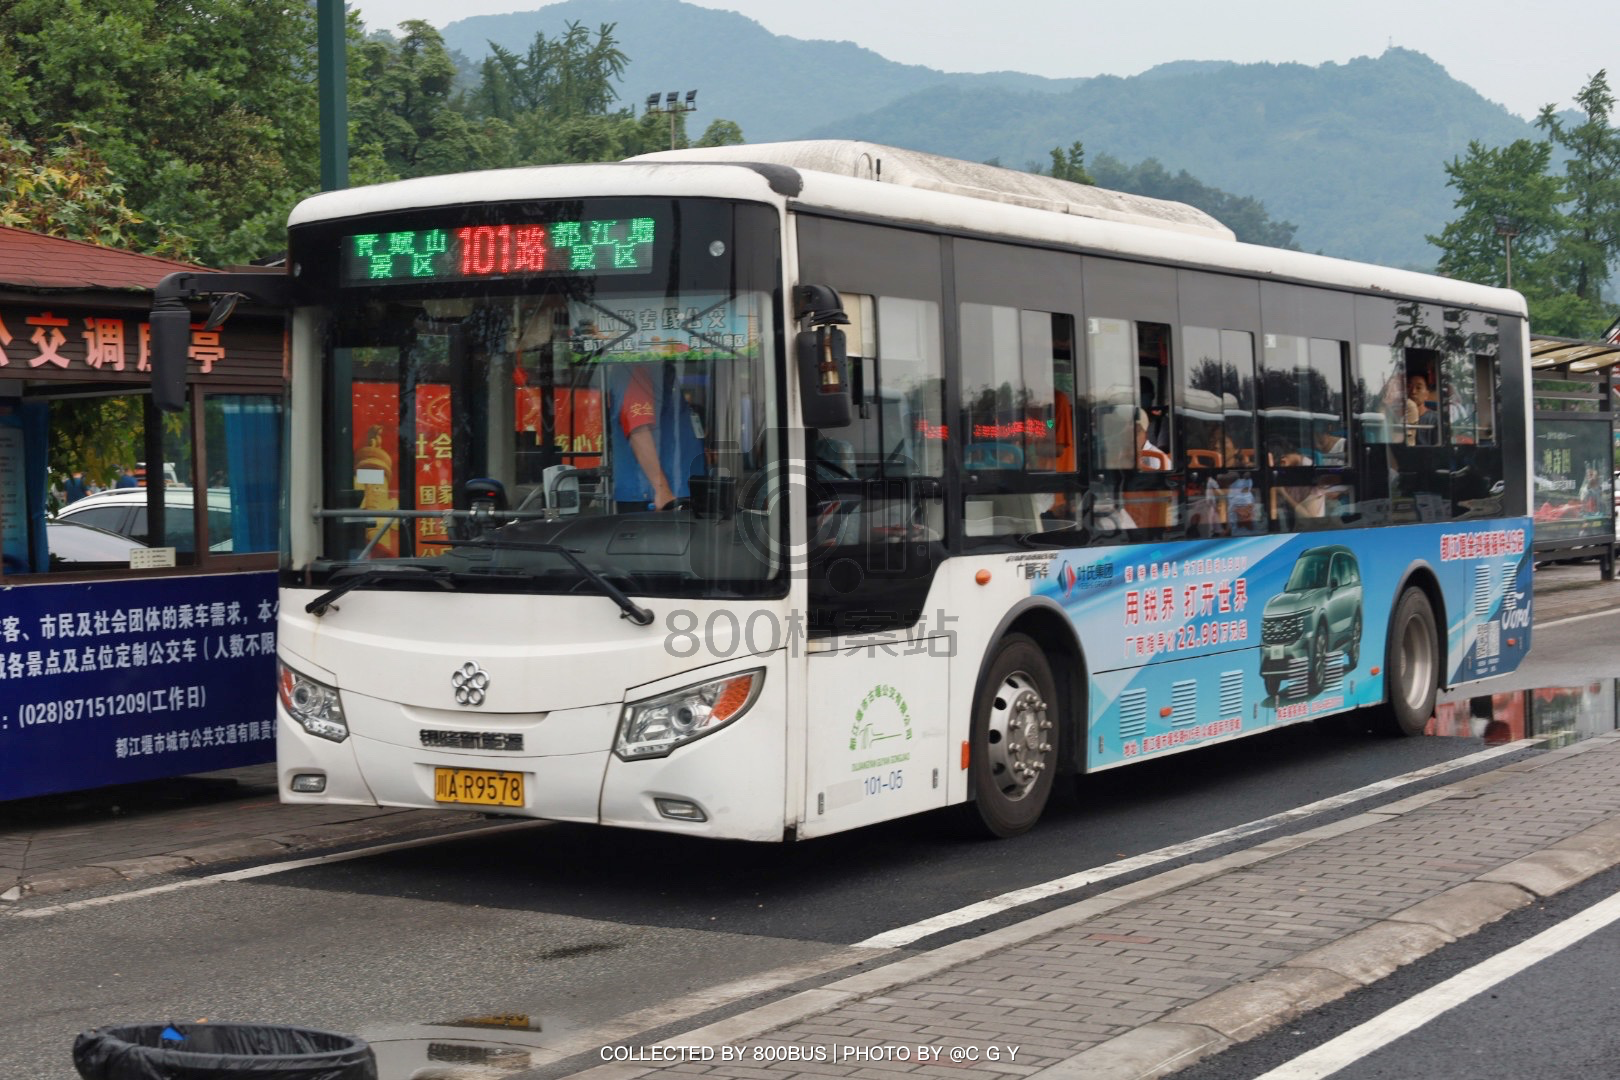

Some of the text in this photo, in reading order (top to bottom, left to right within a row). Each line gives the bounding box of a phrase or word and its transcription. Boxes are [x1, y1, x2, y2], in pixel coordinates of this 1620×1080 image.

[552, 218, 655, 247] 都江堰
[458, 224, 546, 275] 101路
[571, 244, 639, 271] 景区
[370, 253, 436, 279] 景区
[0, 312, 226, 374] 交调亭
[0, 599, 279, 642] 客、市民及社会团体的乘车需求，本
[864, 769, 904, 796] 101-05
